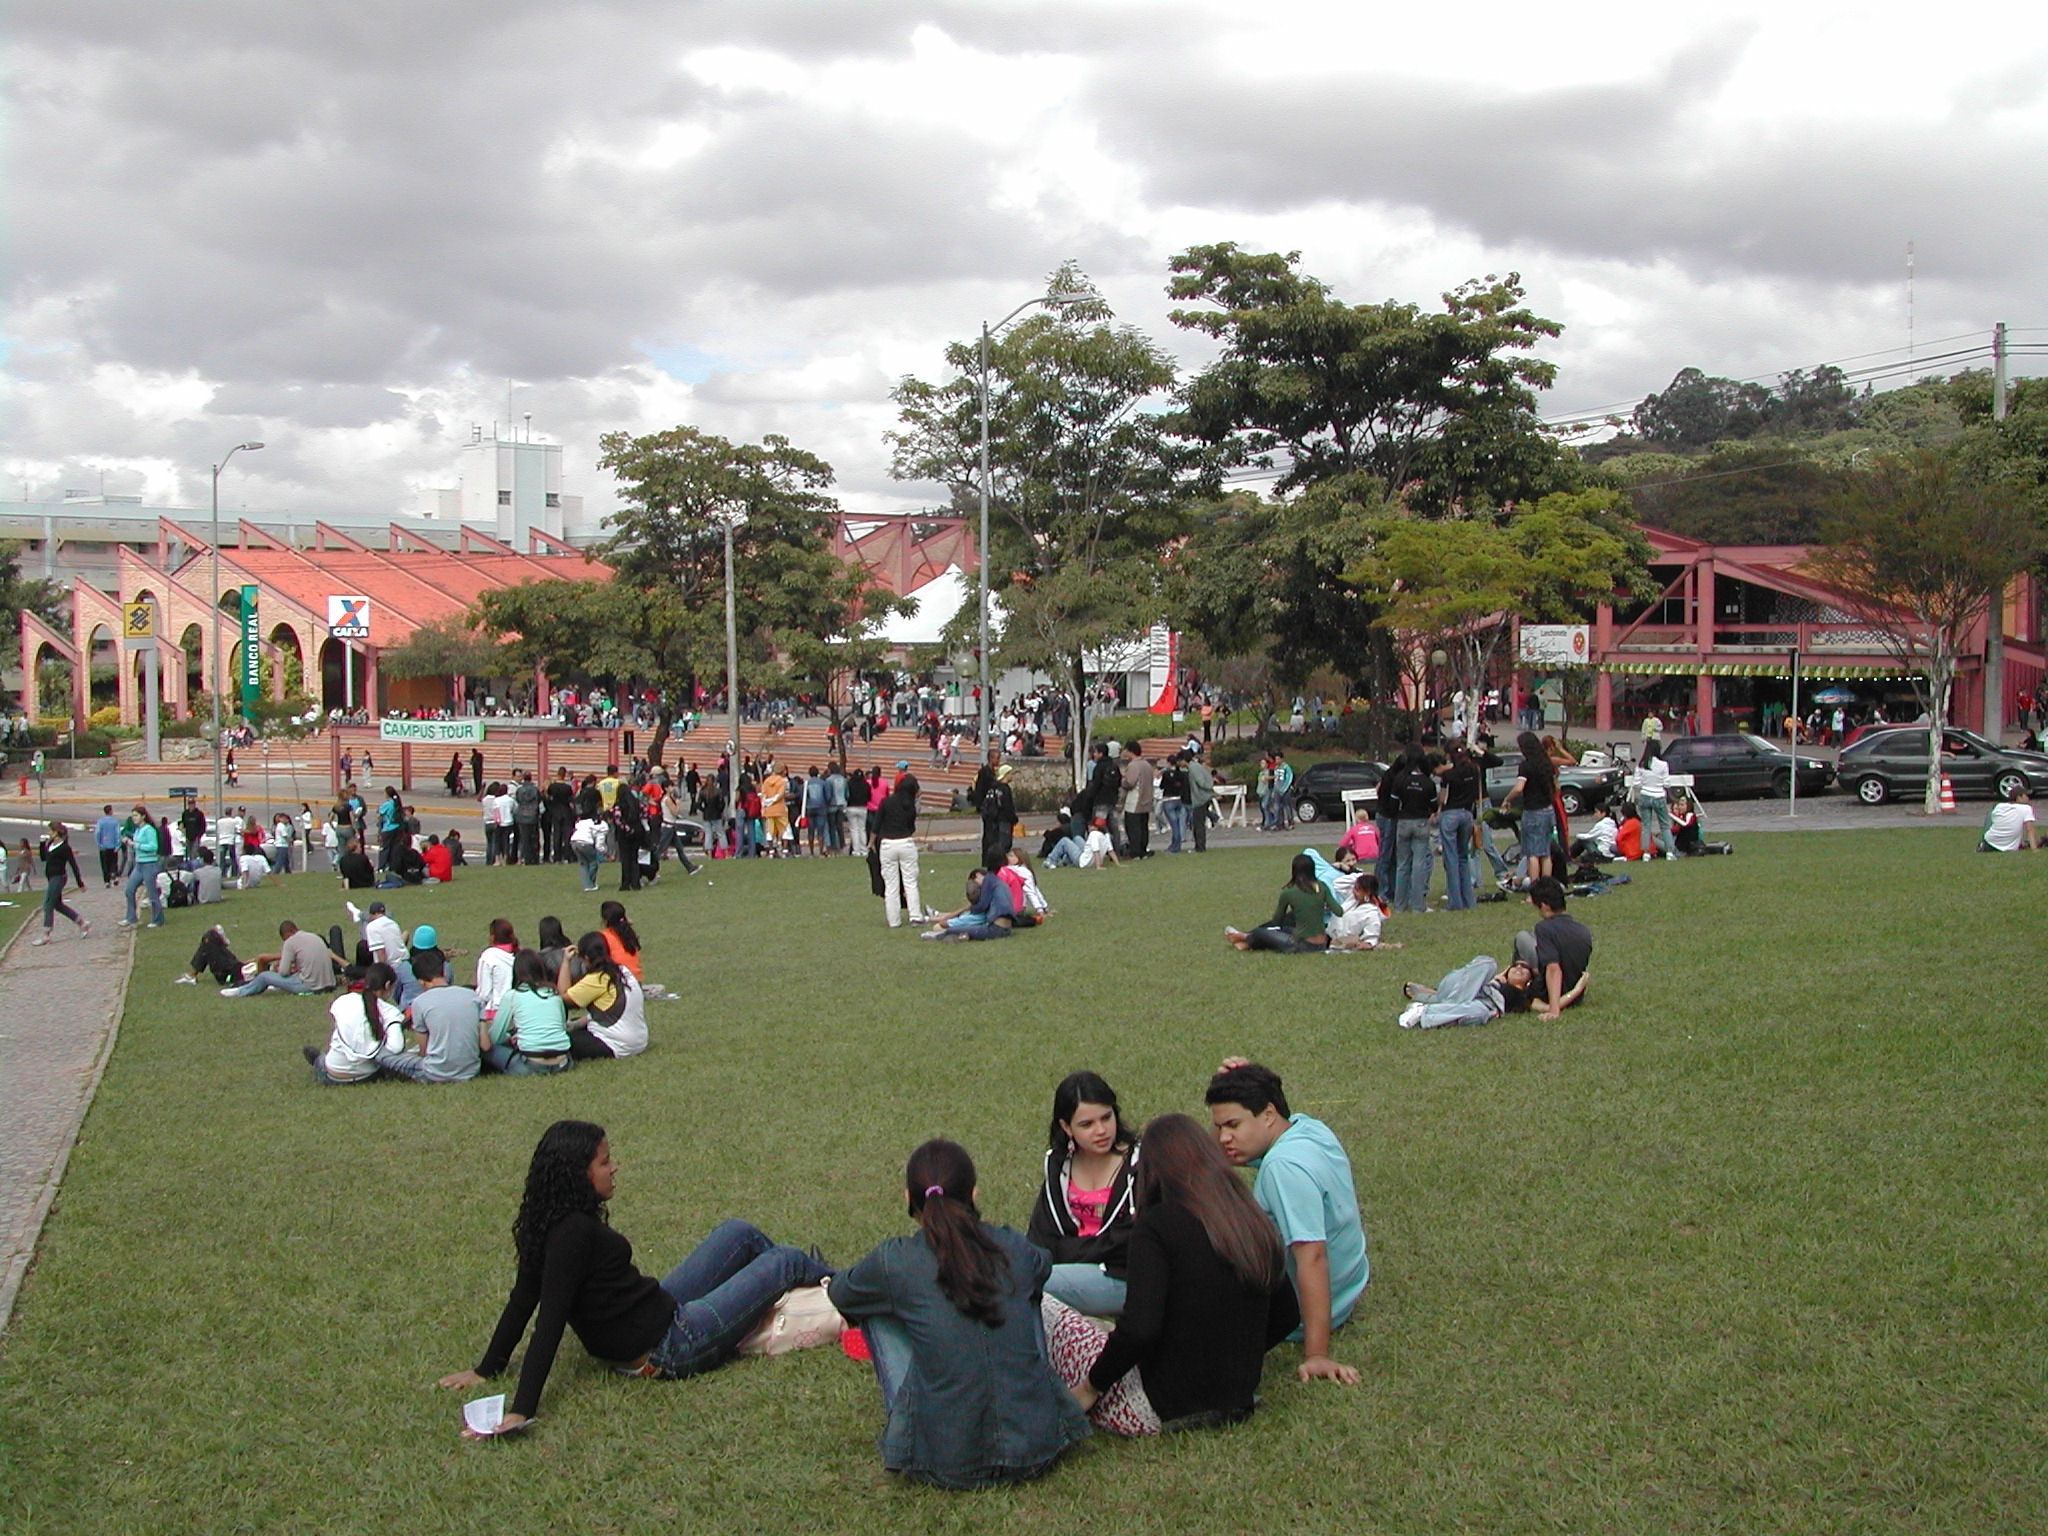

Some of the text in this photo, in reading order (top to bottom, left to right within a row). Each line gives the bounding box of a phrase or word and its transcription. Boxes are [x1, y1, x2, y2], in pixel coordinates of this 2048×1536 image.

[333, 627, 368, 637] CAIXA
[248, 613, 259, 686] BANCO REAL
[383, 722, 474, 739] CAMPUS TOUR
